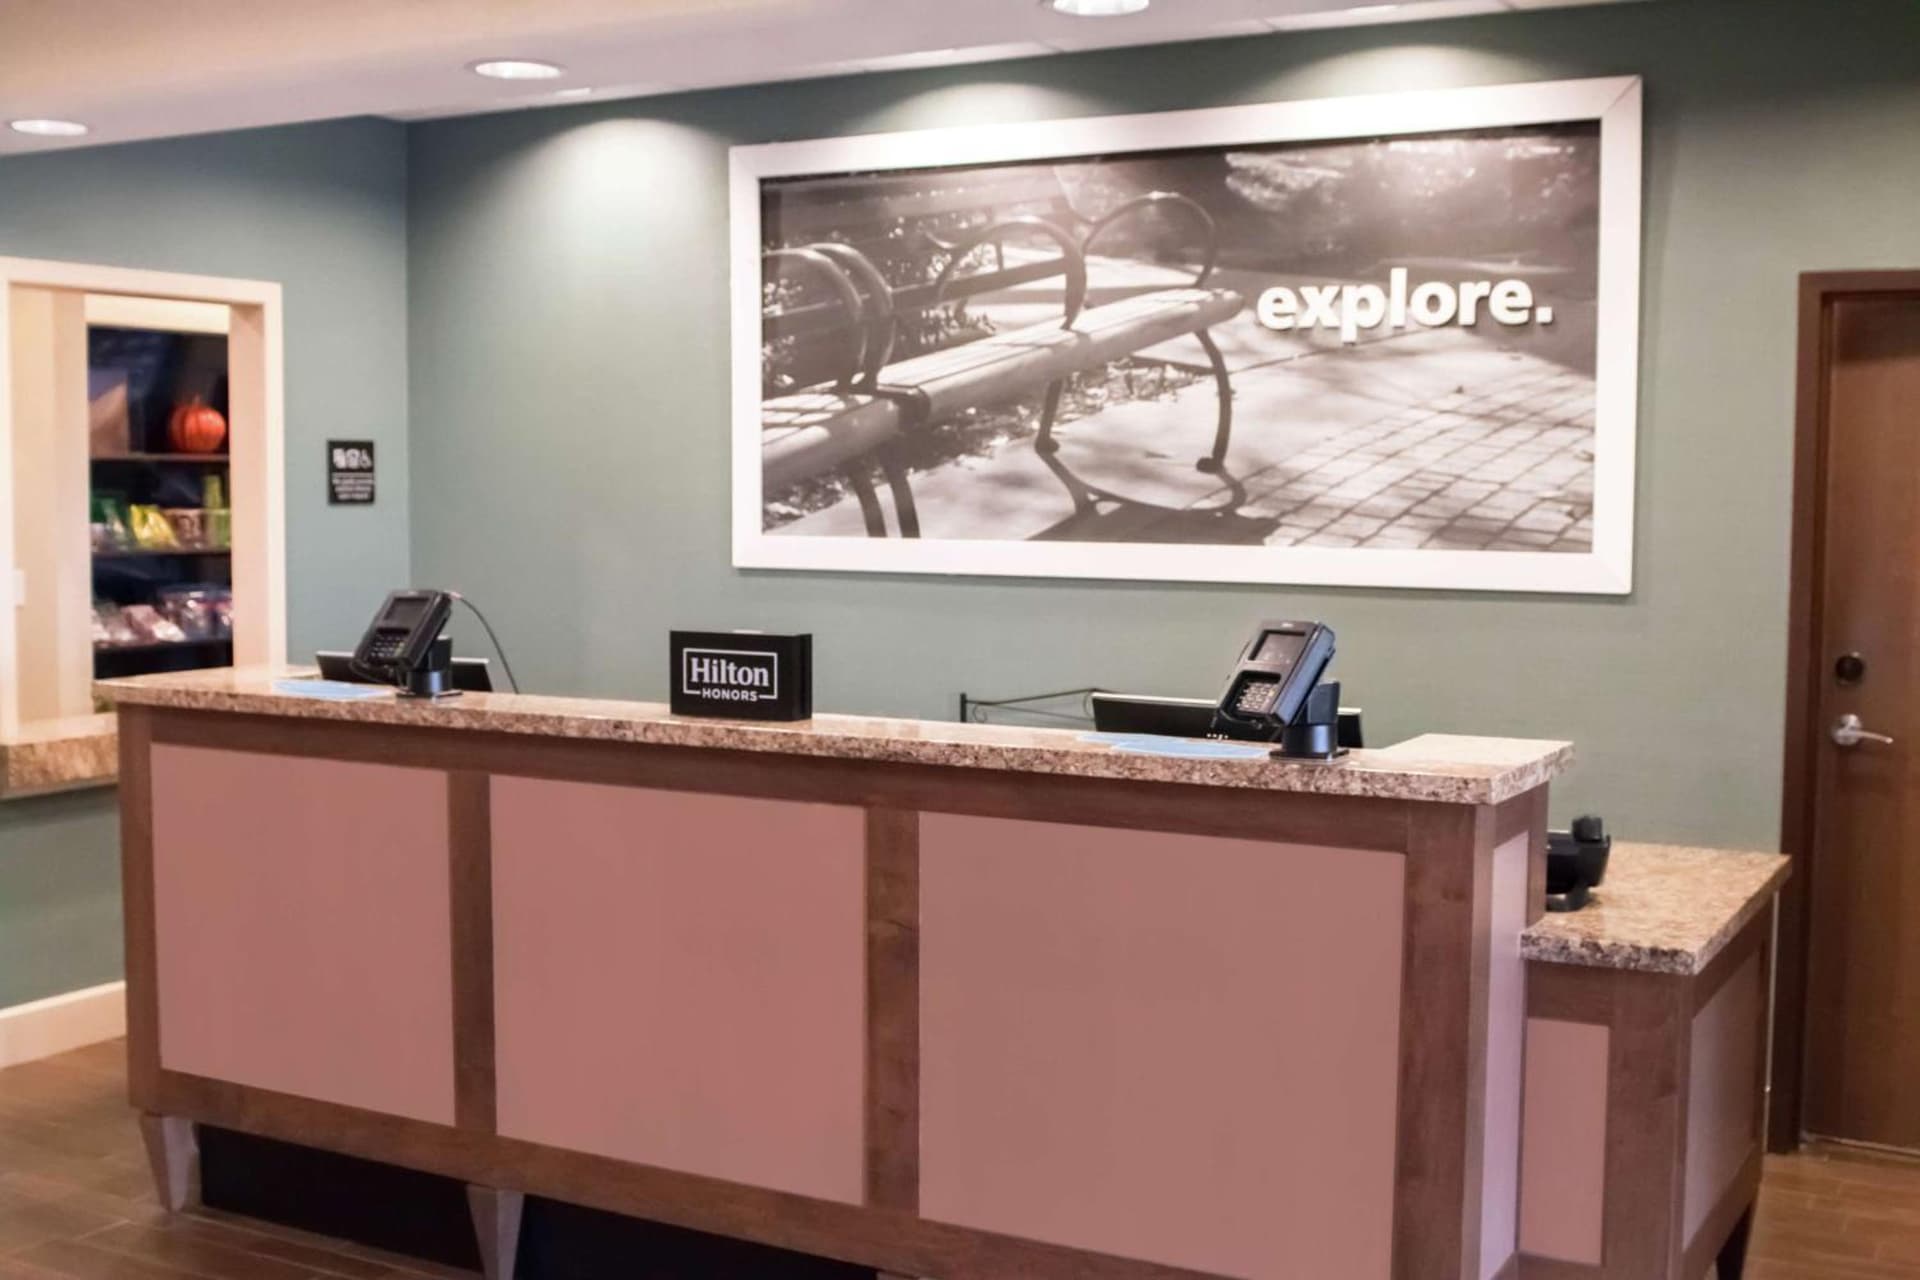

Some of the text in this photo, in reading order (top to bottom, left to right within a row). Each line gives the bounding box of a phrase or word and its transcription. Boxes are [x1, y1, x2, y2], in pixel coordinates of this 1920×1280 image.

[1257, 267, 1553, 343] explore.
[691, 657, 770, 687] Hilton
[702, 688, 758, 701] HONORS
